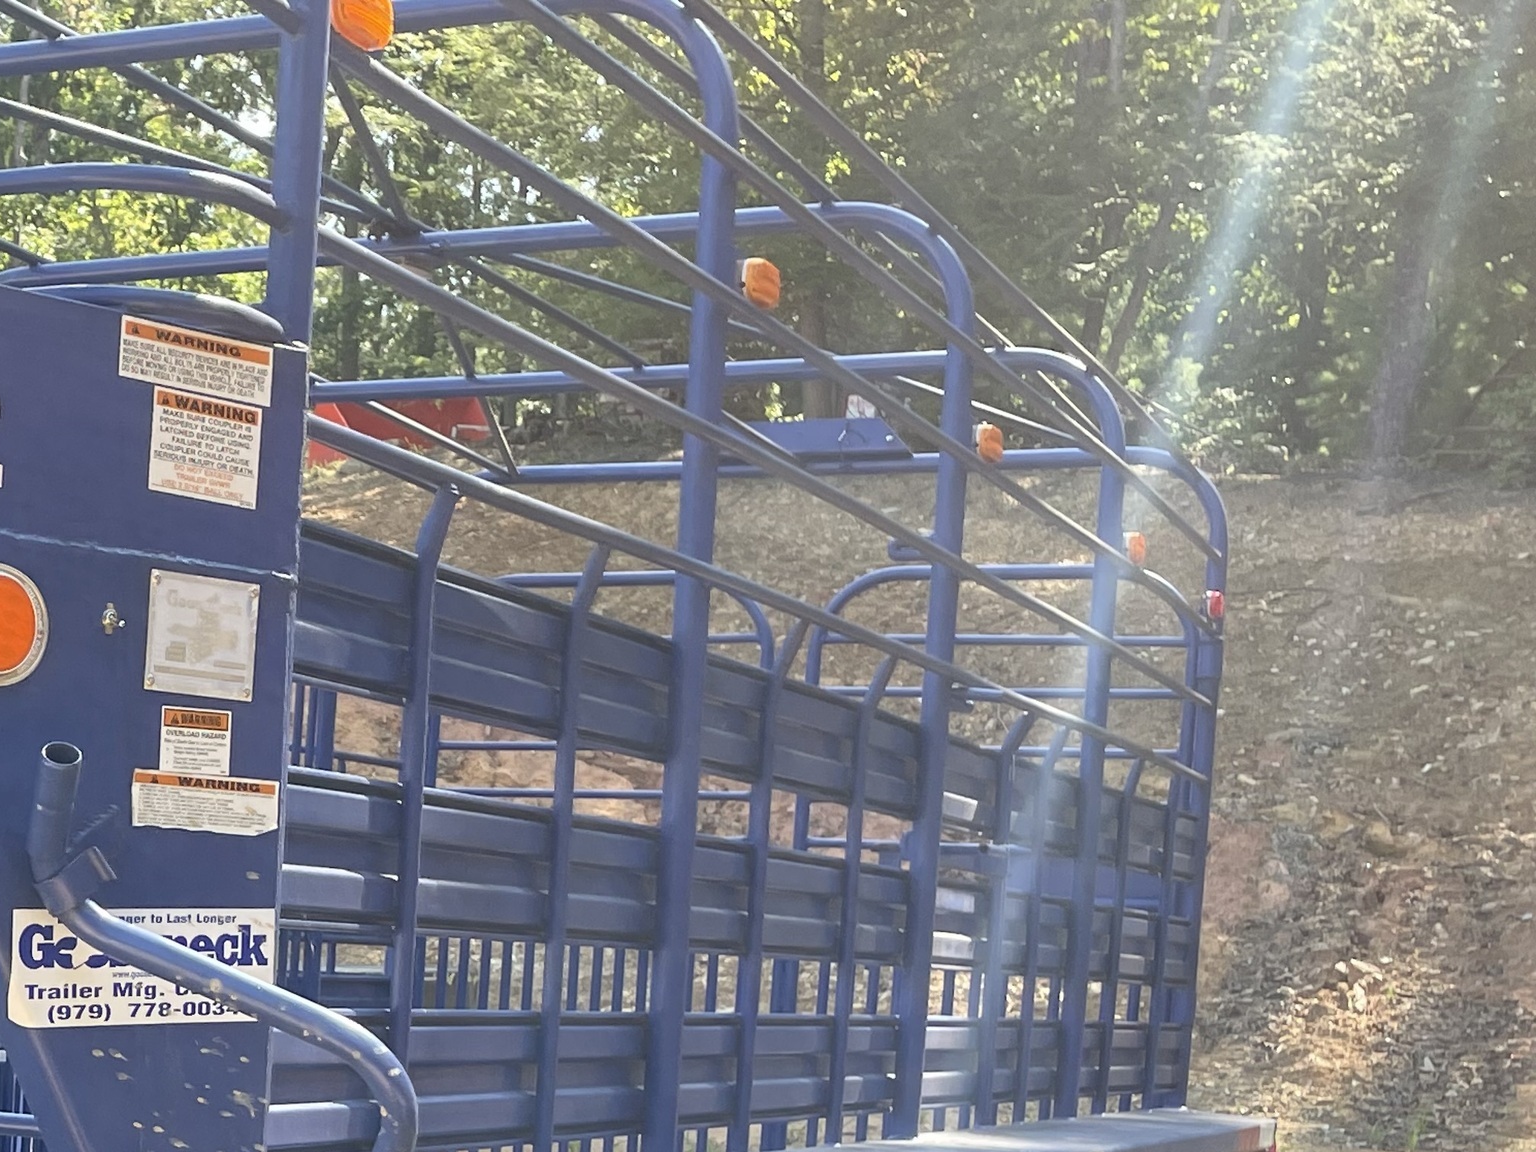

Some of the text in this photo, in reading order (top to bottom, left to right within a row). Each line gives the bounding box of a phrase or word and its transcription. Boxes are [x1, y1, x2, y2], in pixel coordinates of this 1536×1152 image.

[156, 330, 241, 357] WARNING
[175, 395, 255, 423] WARNING
[162, 408, 184, 419] MAKE
[187, 412, 205, 423] SURE
[208, 418, 243, 430] COUPLER
[160, 416, 253, 442] PROPERLY ENGAGED AND
[160, 425, 194, 438] LATCHED
[196, 432, 225, 445] BEFORE
[160, 443, 250, 466] COUPLER COULD CAUSE
[172, 436, 240, 455] FAILURE TO LATCH
[154, 450, 187, 463] SERIOUS
[188, 458, 215, 468] INJURY
[181, 713, 221, 727] WARNING
[166, 729, 226, 740] OVERLOAD HAZARD
[177, 776, 261, 793] WARNING
[151, 913, 163, 923] to
[167, 913, 192, 924] Last
[196, 913, 237, 925] Longer
[24, 983, 103, 1000] Trailer
[113, 982, 164, 999] Mfg.
[47, 1003, 112, 1024] (979)
